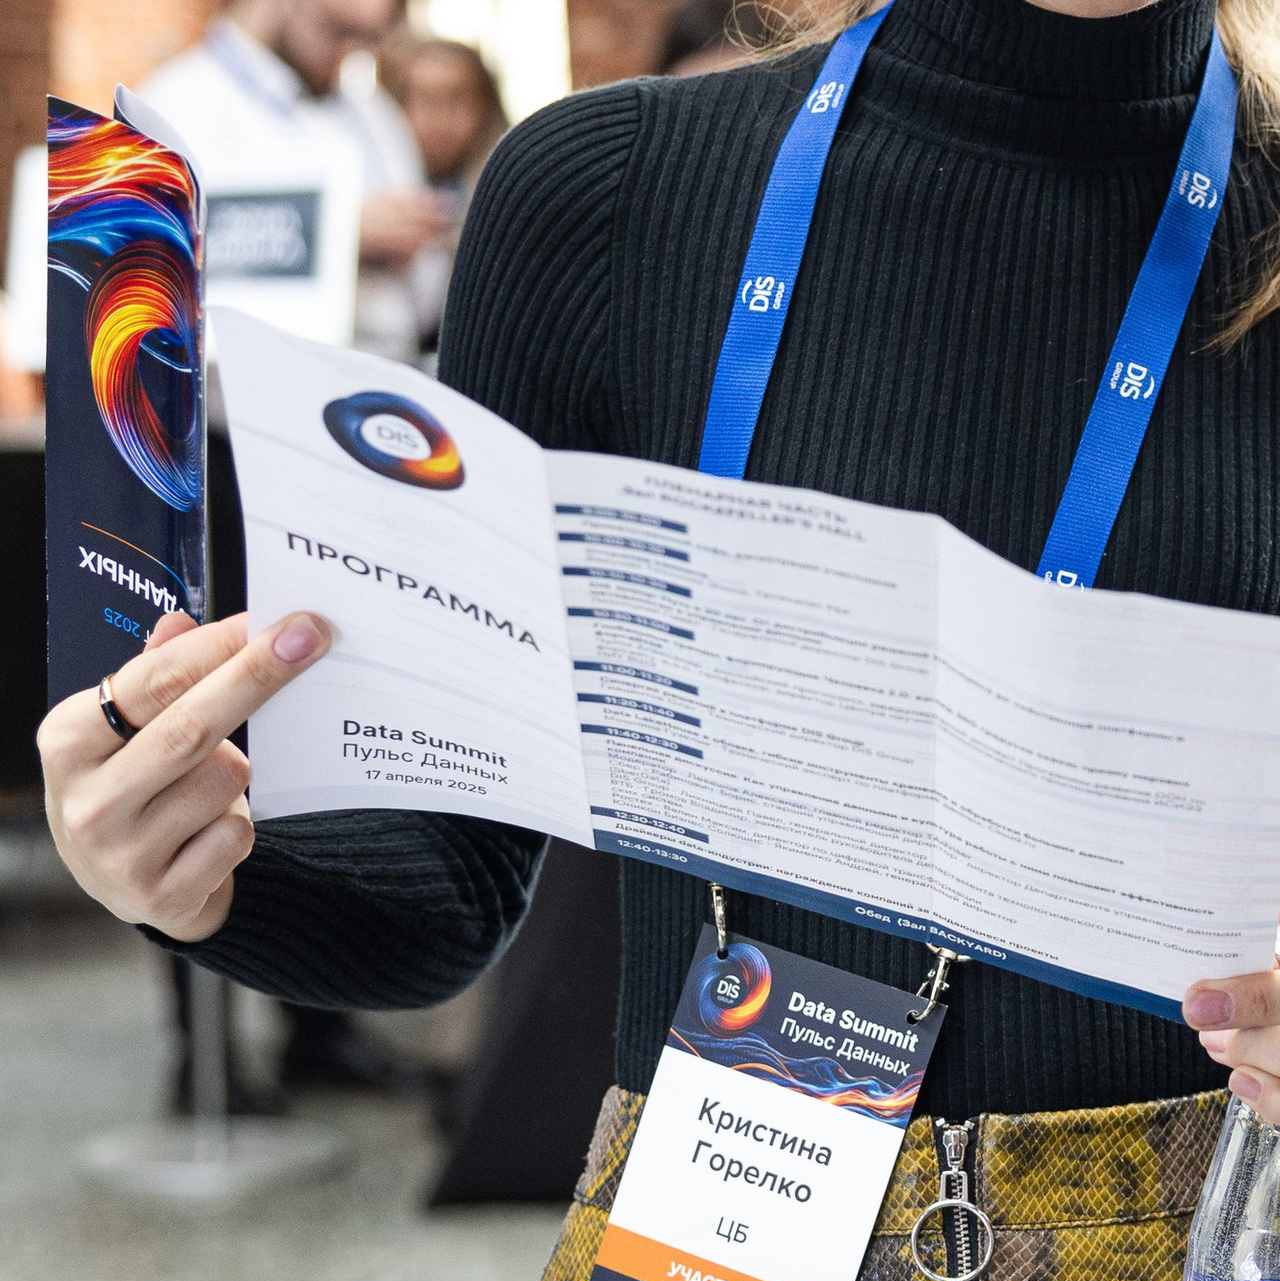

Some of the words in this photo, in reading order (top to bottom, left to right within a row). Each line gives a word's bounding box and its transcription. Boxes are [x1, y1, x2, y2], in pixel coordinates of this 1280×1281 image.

[810, 81, 837, 114] DIS
[1187, 171, 1212, 209] DIS
[749, 276, 775, 312] DIS
[1119, 362, 1148, 400] DIS
[376, 424, 419, 449] DIS
[78, 545, 178, 614] ДАННЫХ
[286, 531, 541, 653] ПРОГРАММА
[104, 607, 141, 638] 2025
[343, 719, 403, 742] Data
[411, 730, 508, 768] Summit
[606, 726, 678, 751] 11:40-12:30
[343, 742, 414, 762] Пульс
[420, 752, 509, 785] Данных
[365, 769, 381, 780] 17
[385, 772, 443, 787] апреля
[448, 779, 487, 795] 2025
[610, 785, 638, 797] ских
[641, 792, 682, 809] систем
[614, 809, 685, 835] 12:30-12:40
[617, 838, 687, 864] 12:40-13:30
[615, 821, 676, 845] Драйверы
[775, 867, 853, 896] награждение
[856, 888, 914, 910] компаний
[932, 910, 1006, 944] выдающиеся
[1008, 939, 1058, 963] проекты
[854, 905, 890, 923] Обед
[896, 916, 926, 933] (Зал
[927, 925, 1006, 961] BACKYARD)
[716, 979, 741, 999] DIS
[788, 991, 836, 1024] Data
[839, 1009, 919, 1053] Summit
[780, 1017, 836, 1050] Пульс
[836, 1037, 911, 1077] Данных
[698, 1097, 832, 1166] Кристина
[692, 1139, 812, 1203] Горелко
[716, 1216, 749, 1244] ЦБ
